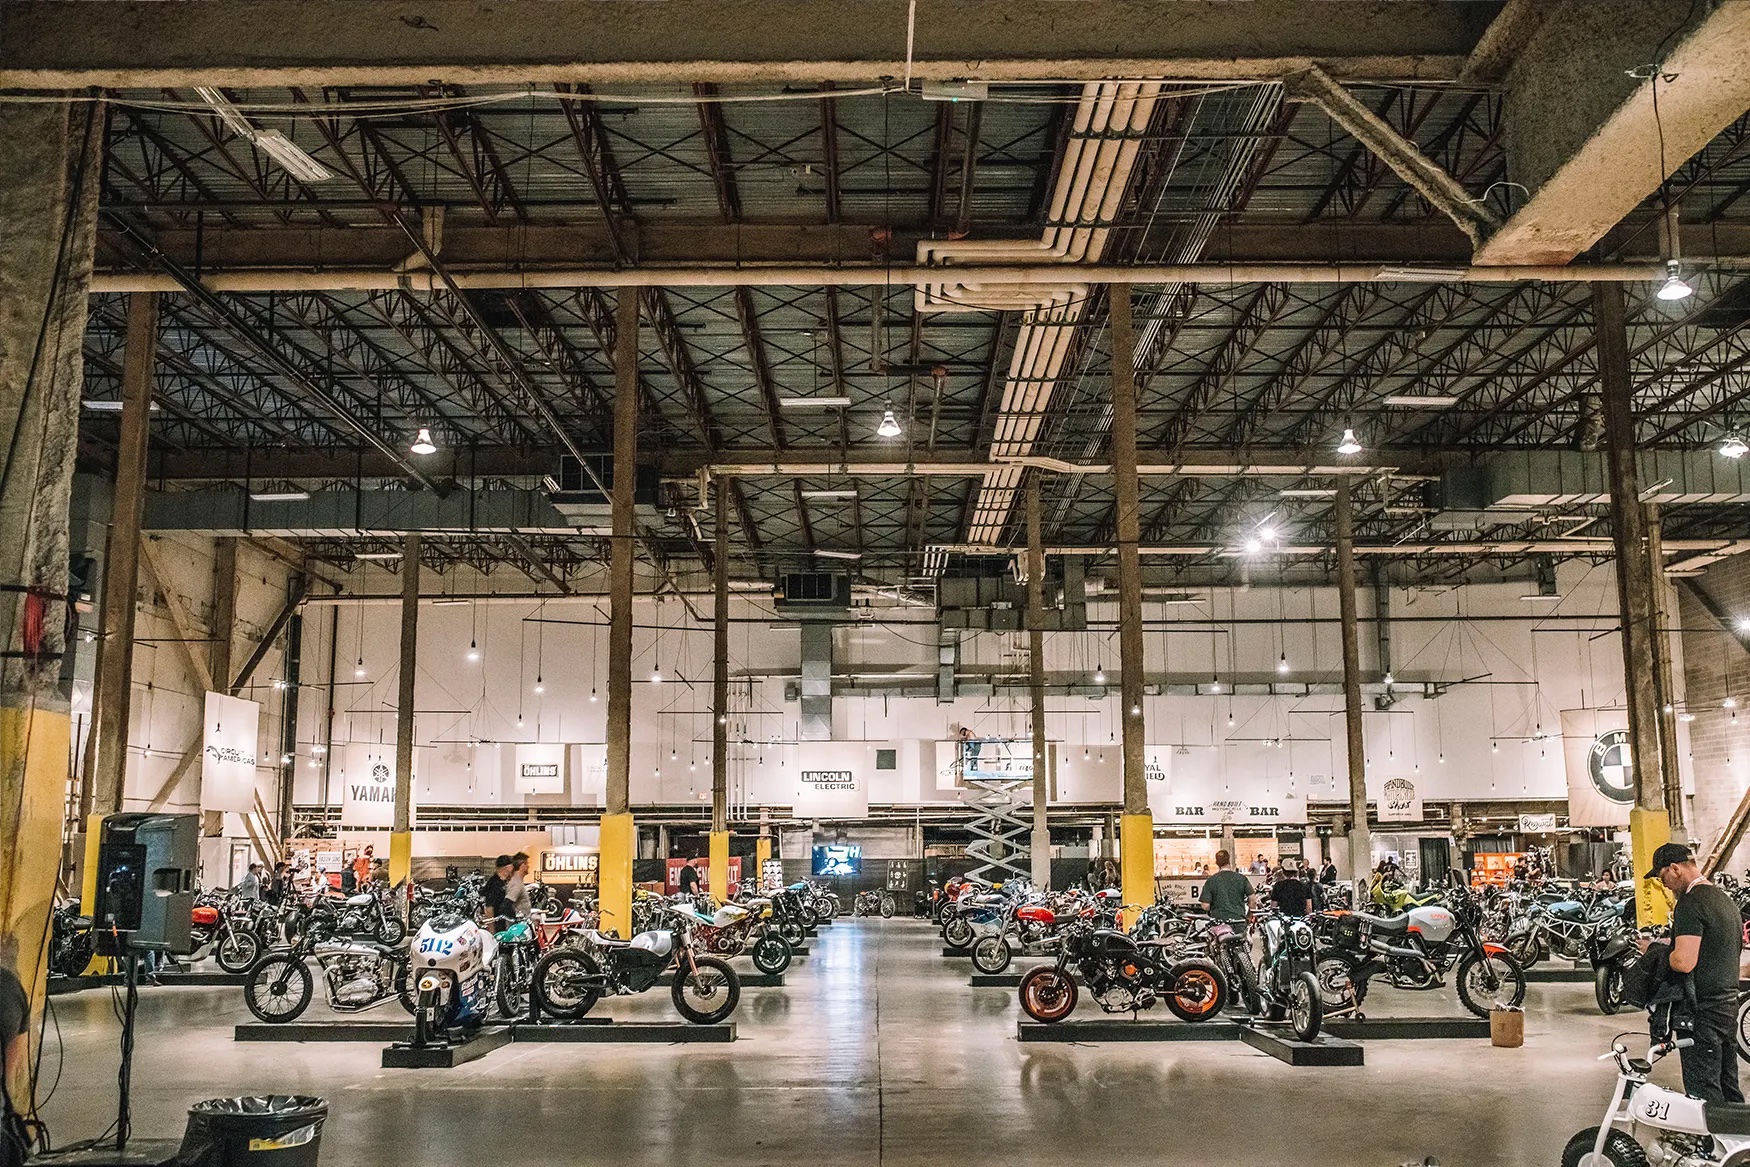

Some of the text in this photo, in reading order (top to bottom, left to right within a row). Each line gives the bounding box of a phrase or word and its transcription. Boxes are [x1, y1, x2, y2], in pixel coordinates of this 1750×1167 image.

[1144, 764, 1161, 772] YAL
[803, 771, 850, 782] LINCOLN
[1146, 772, 1165, 781] IELD
[350, 784, 396, 802] YAMAH
[1175, 806, 1205, 815] BAR
[1249, 807, 1280, 816] BAR
[545, 853, 598, 871] ÖHLINS
[420, 937, 453, 956] 5112
[1645, 1099, 1670, 1121] 31
